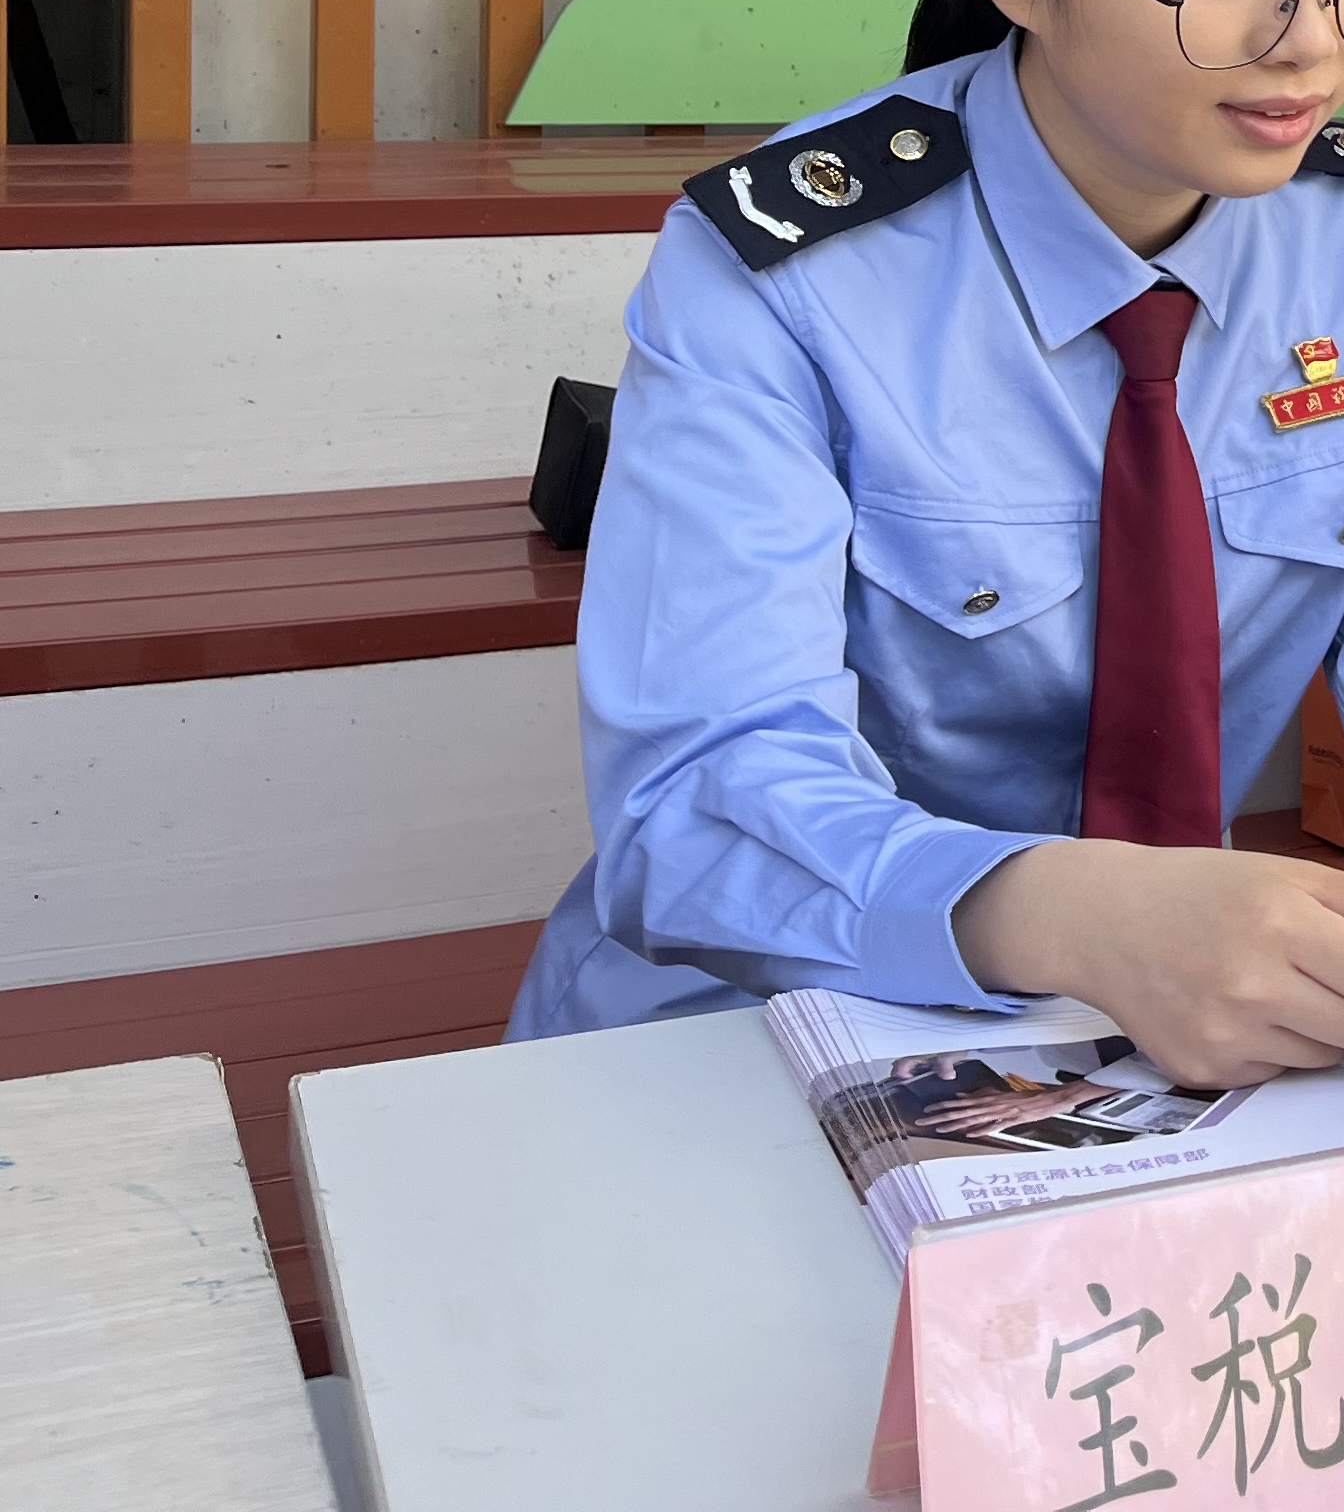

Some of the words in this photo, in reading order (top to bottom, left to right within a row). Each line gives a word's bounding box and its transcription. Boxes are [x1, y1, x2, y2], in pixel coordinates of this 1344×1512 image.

[959, 1148, 1210, 1187] 人力资源社会保障部
[960, 1182, 1049, 1202] 财政部
